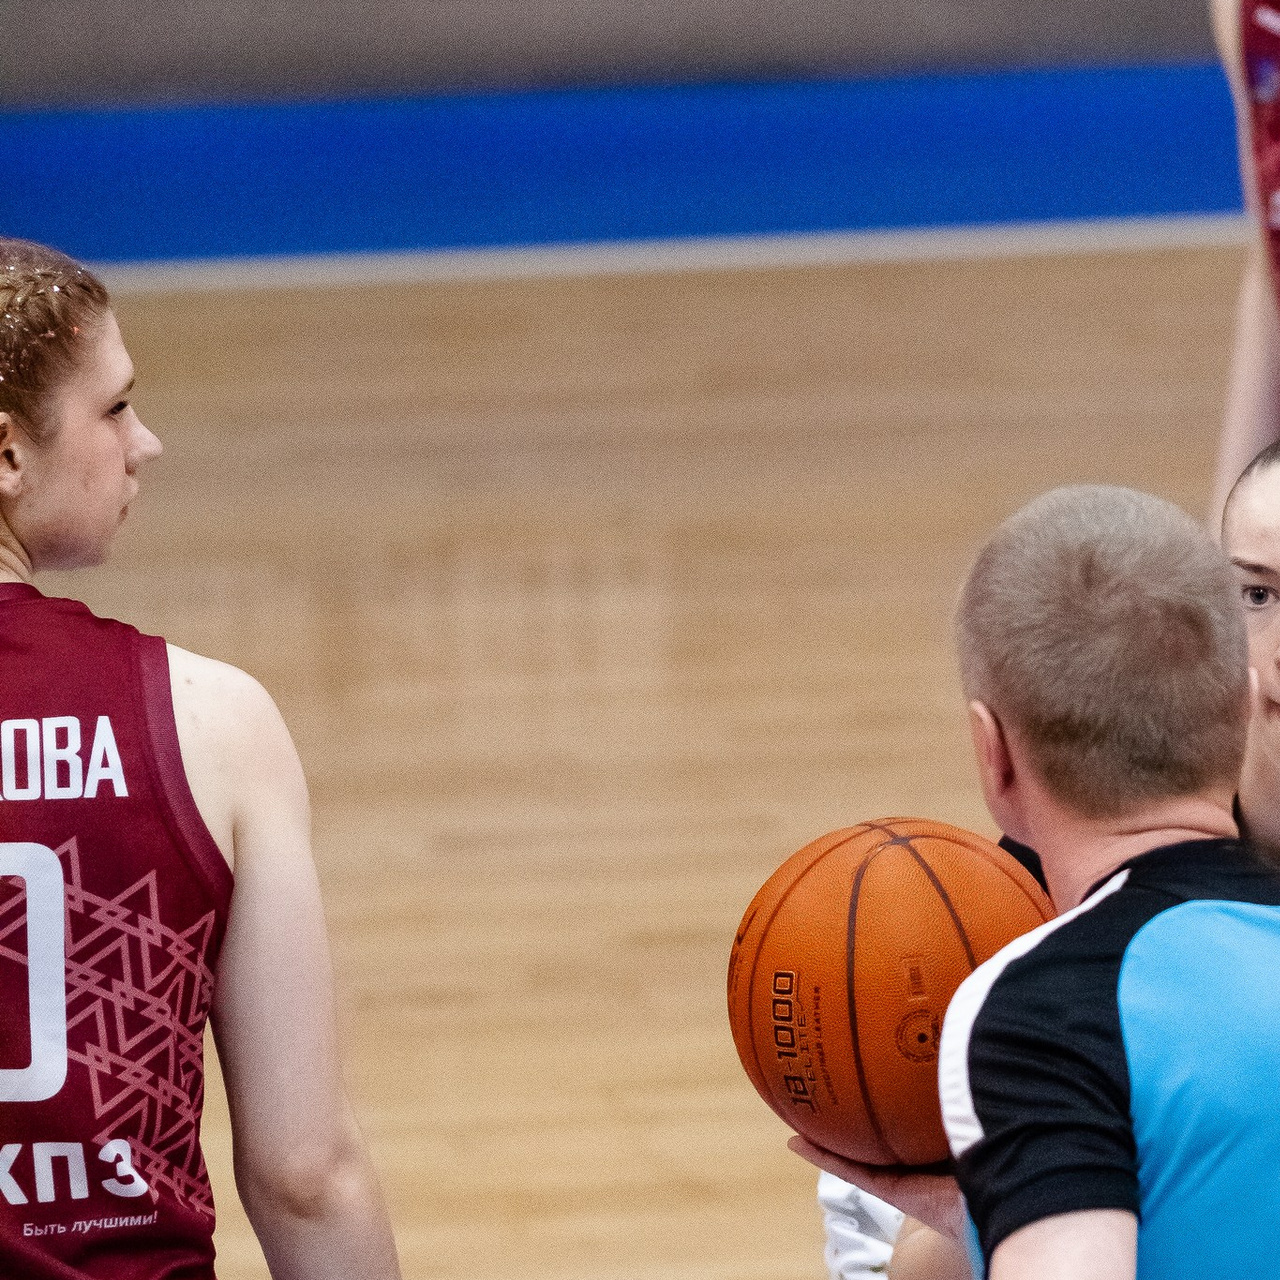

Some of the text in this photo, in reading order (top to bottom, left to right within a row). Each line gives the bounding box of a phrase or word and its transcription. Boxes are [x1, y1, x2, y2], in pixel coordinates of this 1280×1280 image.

[0, 715, 129, 801] ОВА
[797, 1013, 816, 1082] ELITE
[23, 1210, 158, 1237] Быть лучшими!
